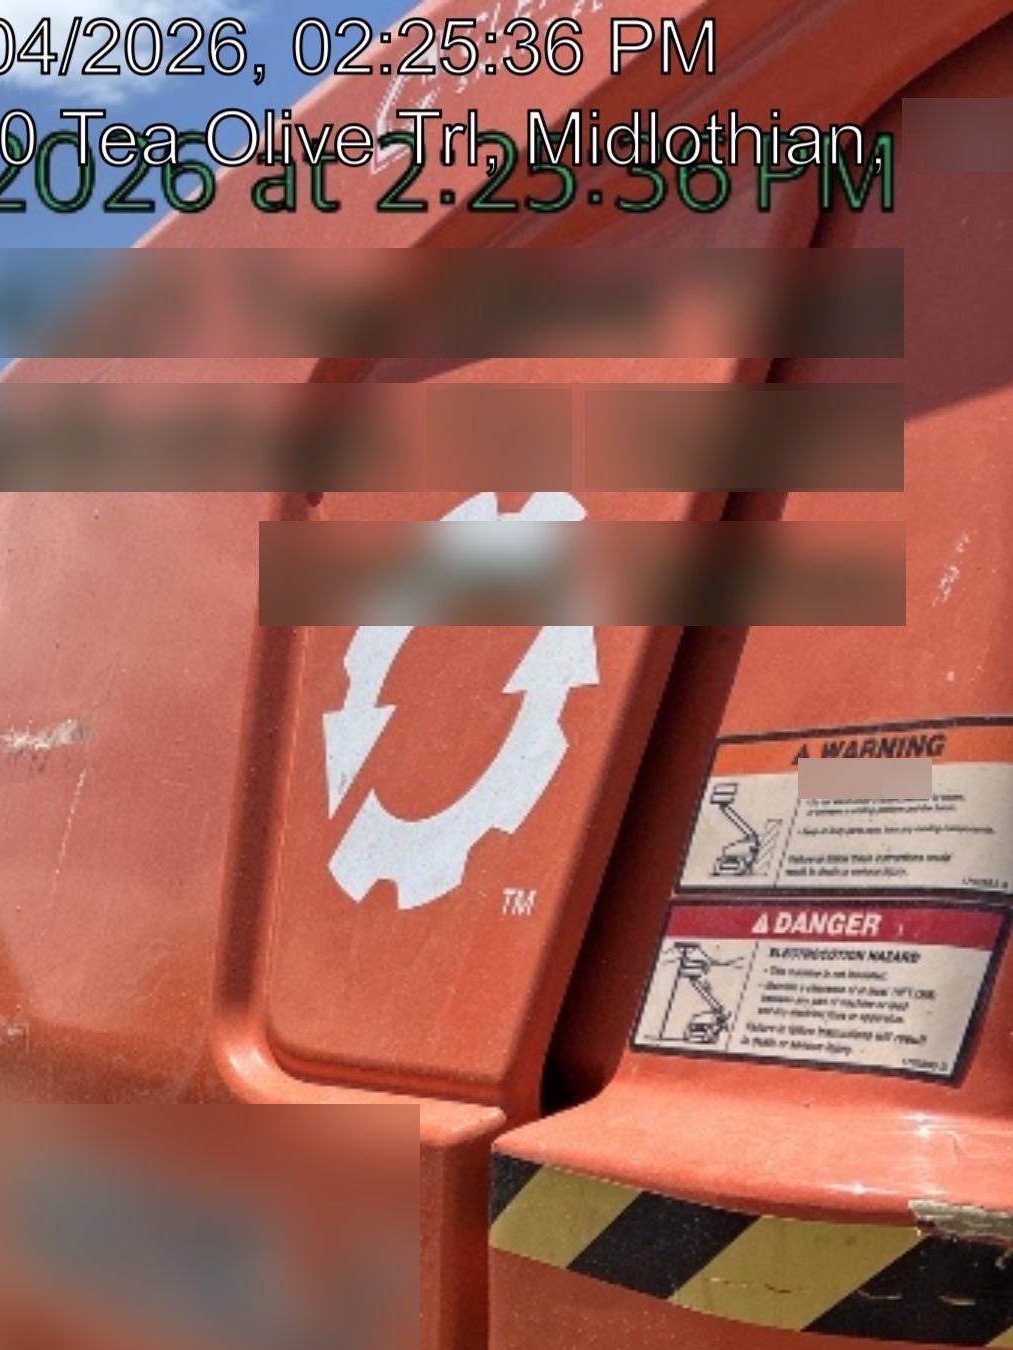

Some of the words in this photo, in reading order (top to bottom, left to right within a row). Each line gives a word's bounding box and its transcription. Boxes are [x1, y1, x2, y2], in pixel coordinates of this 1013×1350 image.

[820, 733, 947, 758] WARNING
[502, 887, 537, 916] TM
[774, 911, 882, 937] DANGER
